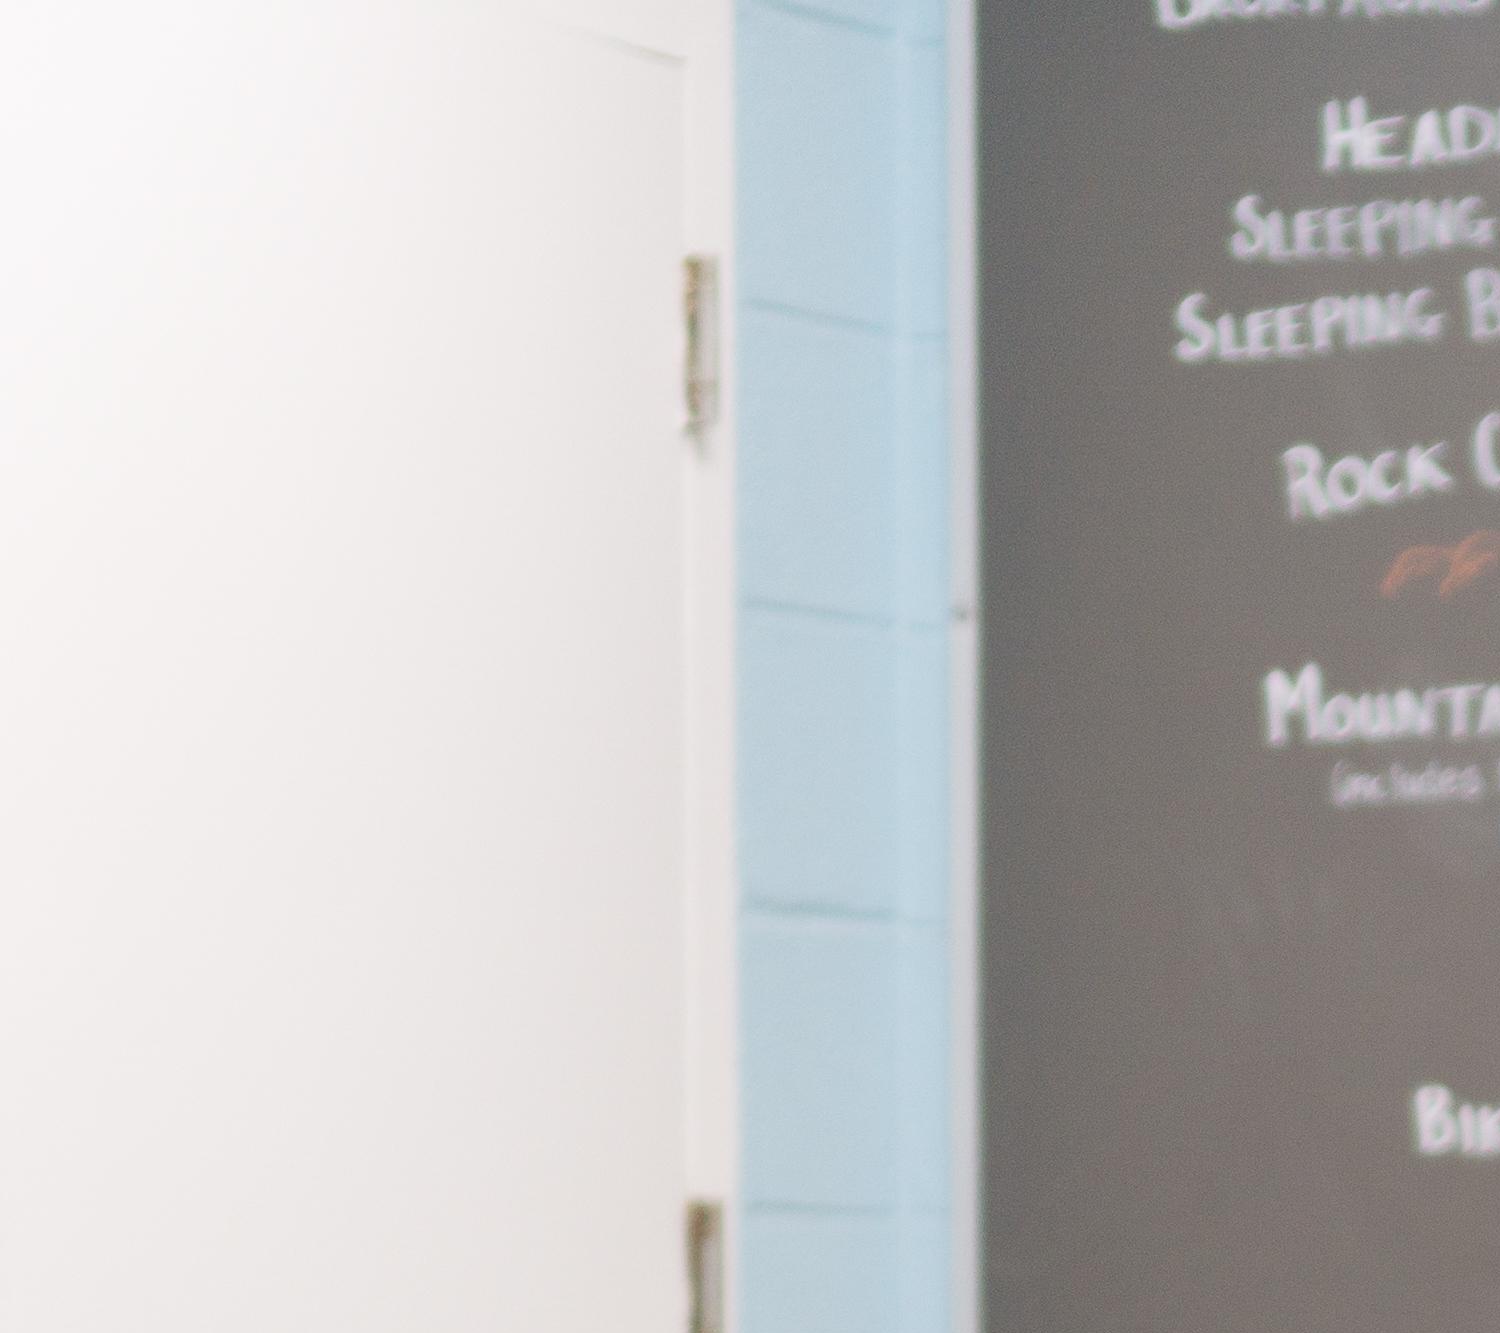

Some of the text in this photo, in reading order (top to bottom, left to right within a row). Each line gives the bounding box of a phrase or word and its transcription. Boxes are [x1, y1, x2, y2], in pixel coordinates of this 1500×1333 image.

[1230, 194, 1499, 259] SLEEPING
[1174, 292, 1445, 362] SLEEPING
[1282, 442, 1451, 520] ROCK
